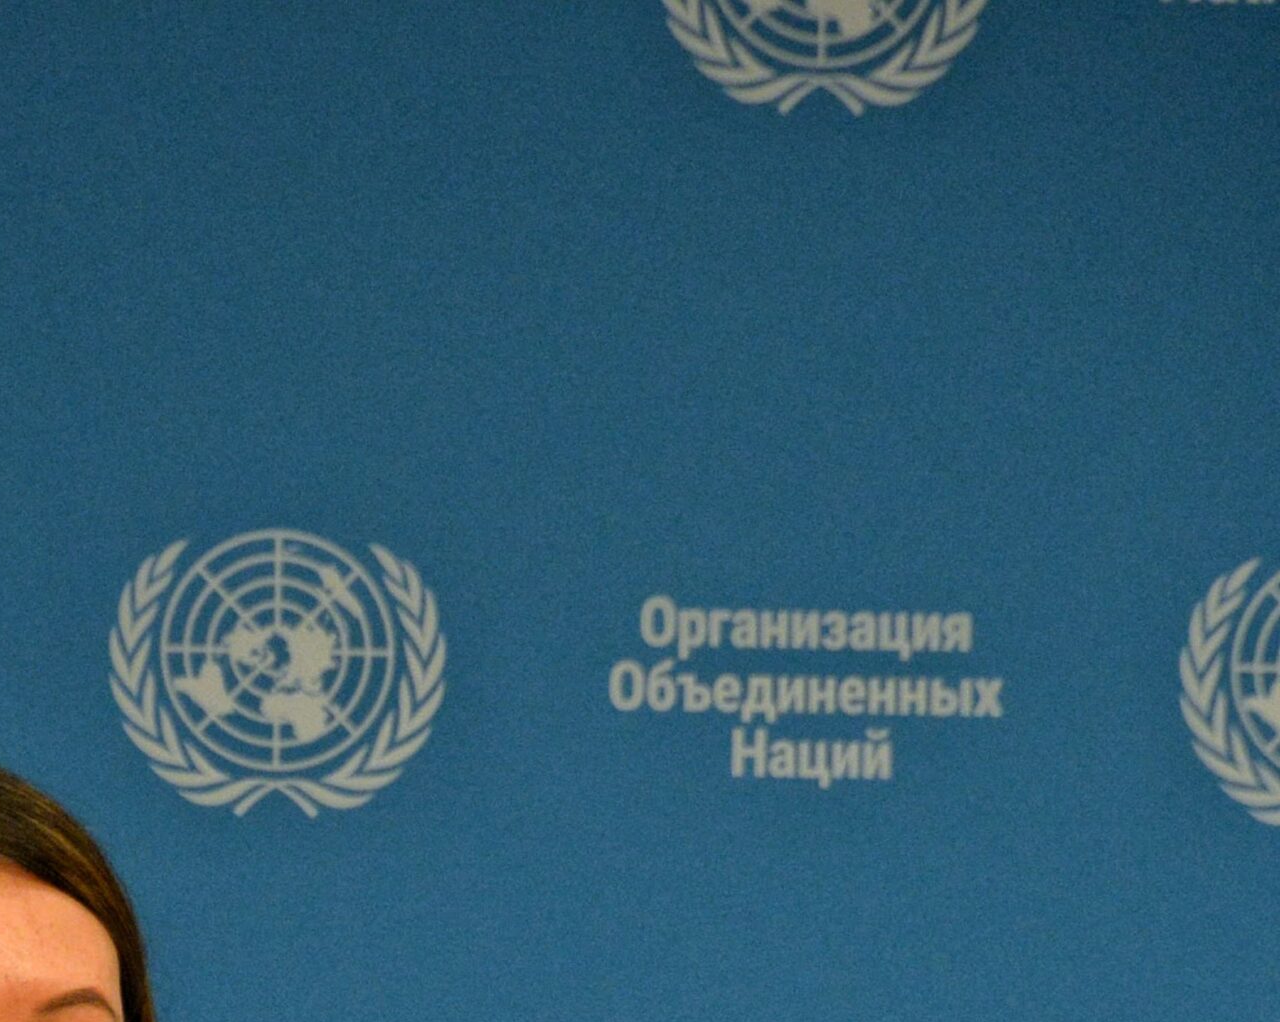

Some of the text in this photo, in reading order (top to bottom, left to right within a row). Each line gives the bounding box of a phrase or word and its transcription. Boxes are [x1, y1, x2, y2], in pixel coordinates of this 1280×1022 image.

[640, 595, 973, 661] Организация
[608, 659, 1003, 724] Объединенных
[730, 727, 893, 789] Наций
